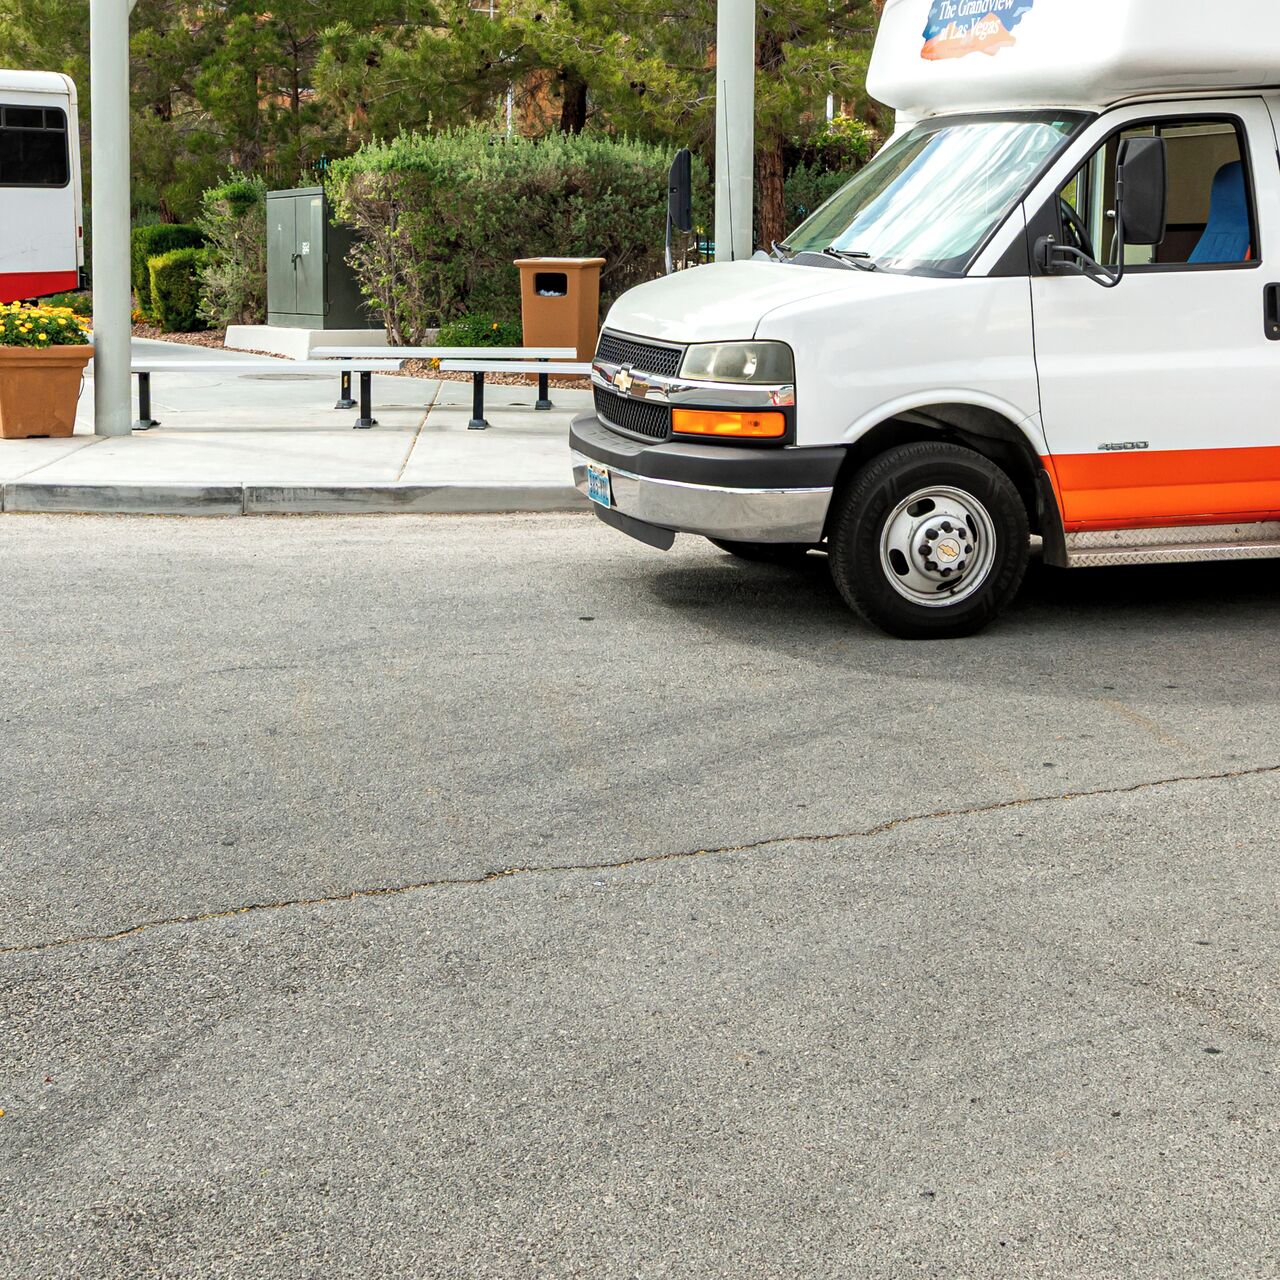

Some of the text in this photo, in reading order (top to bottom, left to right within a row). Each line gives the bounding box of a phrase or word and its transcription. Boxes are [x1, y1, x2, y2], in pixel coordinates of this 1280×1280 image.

[939, 0, 957, 20] The
[949, 21, 969, 40] Las
[971, 17, 1000, 40] Vegas
[1097, 441, 1149, 450] 4500
